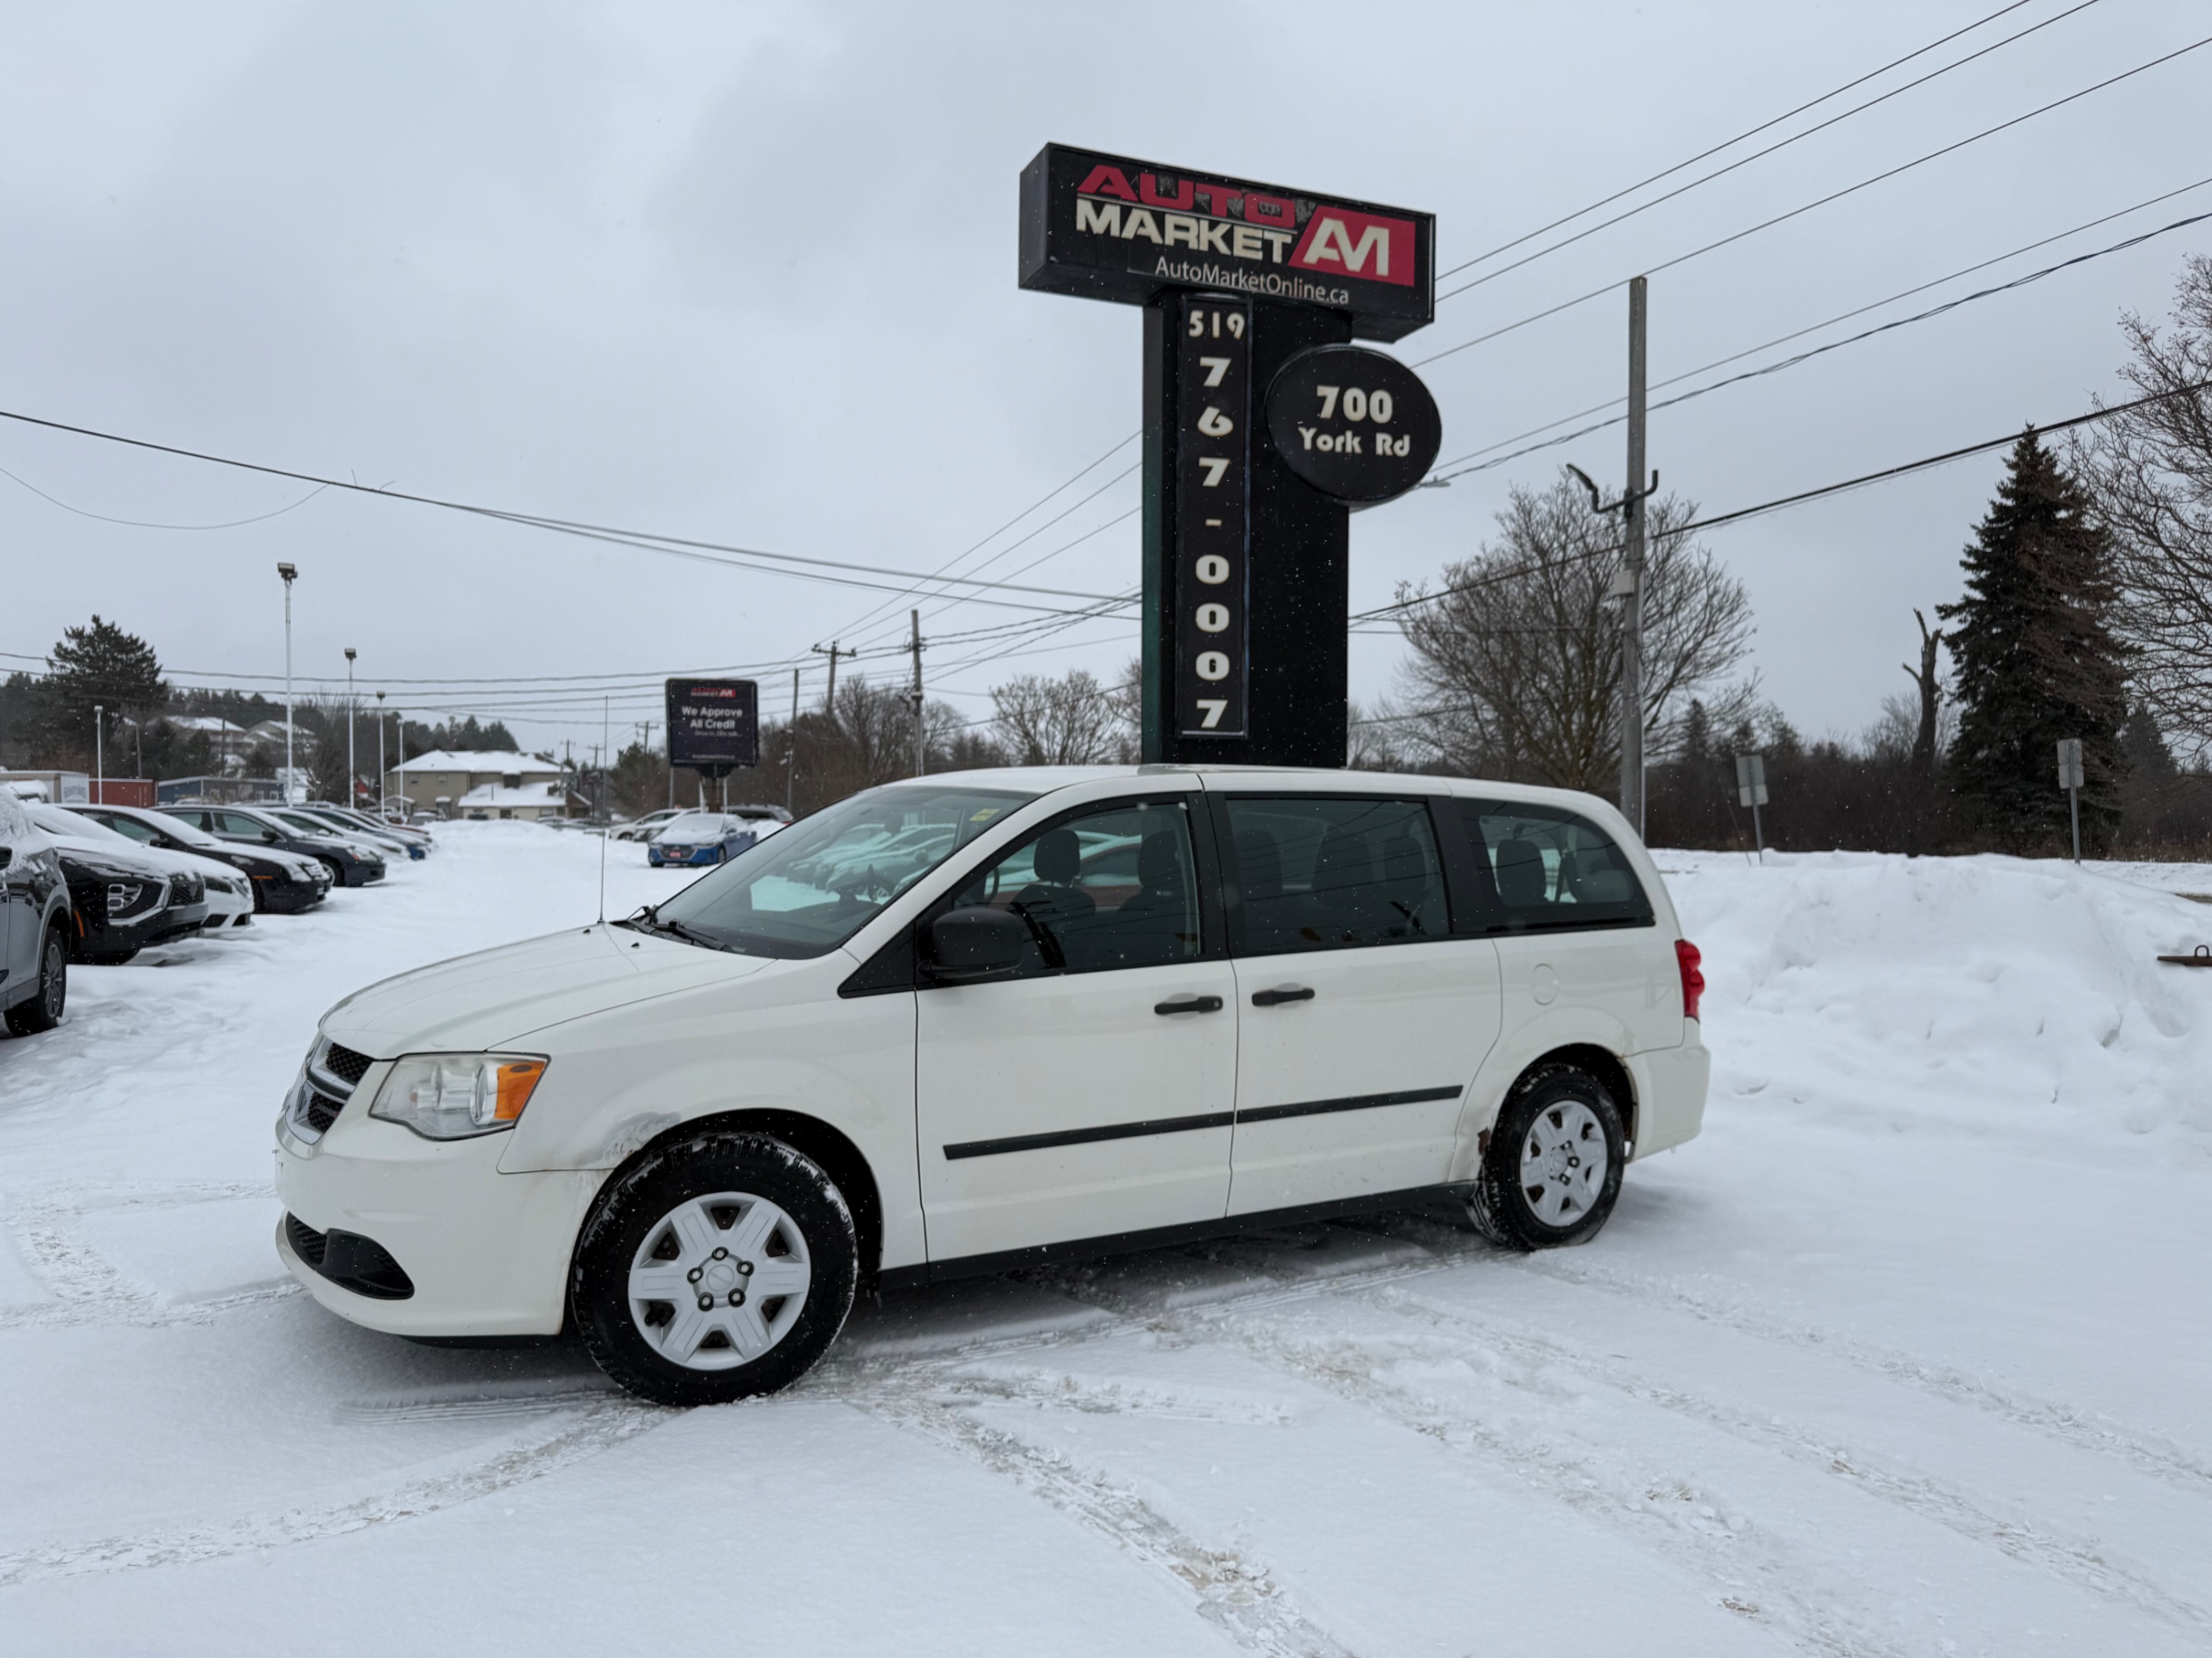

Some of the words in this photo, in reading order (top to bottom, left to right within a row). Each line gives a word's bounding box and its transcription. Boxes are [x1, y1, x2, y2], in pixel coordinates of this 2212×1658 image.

[1077, 164, 1295, 228] AUTO
[1076, 197, 1293, 263] MARKET
[1303, 217, 1390, 277] AM
[1155, 256, 1349, 304] AutoMarketOnline.ca
[1188, 310, 1245, 341] 519
[1317, 385, 1394, 424] 700
[1297, 426, 1363, 455] York
[1375, 432, 1411, 457] Rd
[682, 705, 698, 717] We
[700, 706, 743, 719] Approve
[690, 719, 703, 729] All
[705, 719, 735, 730] Credit
